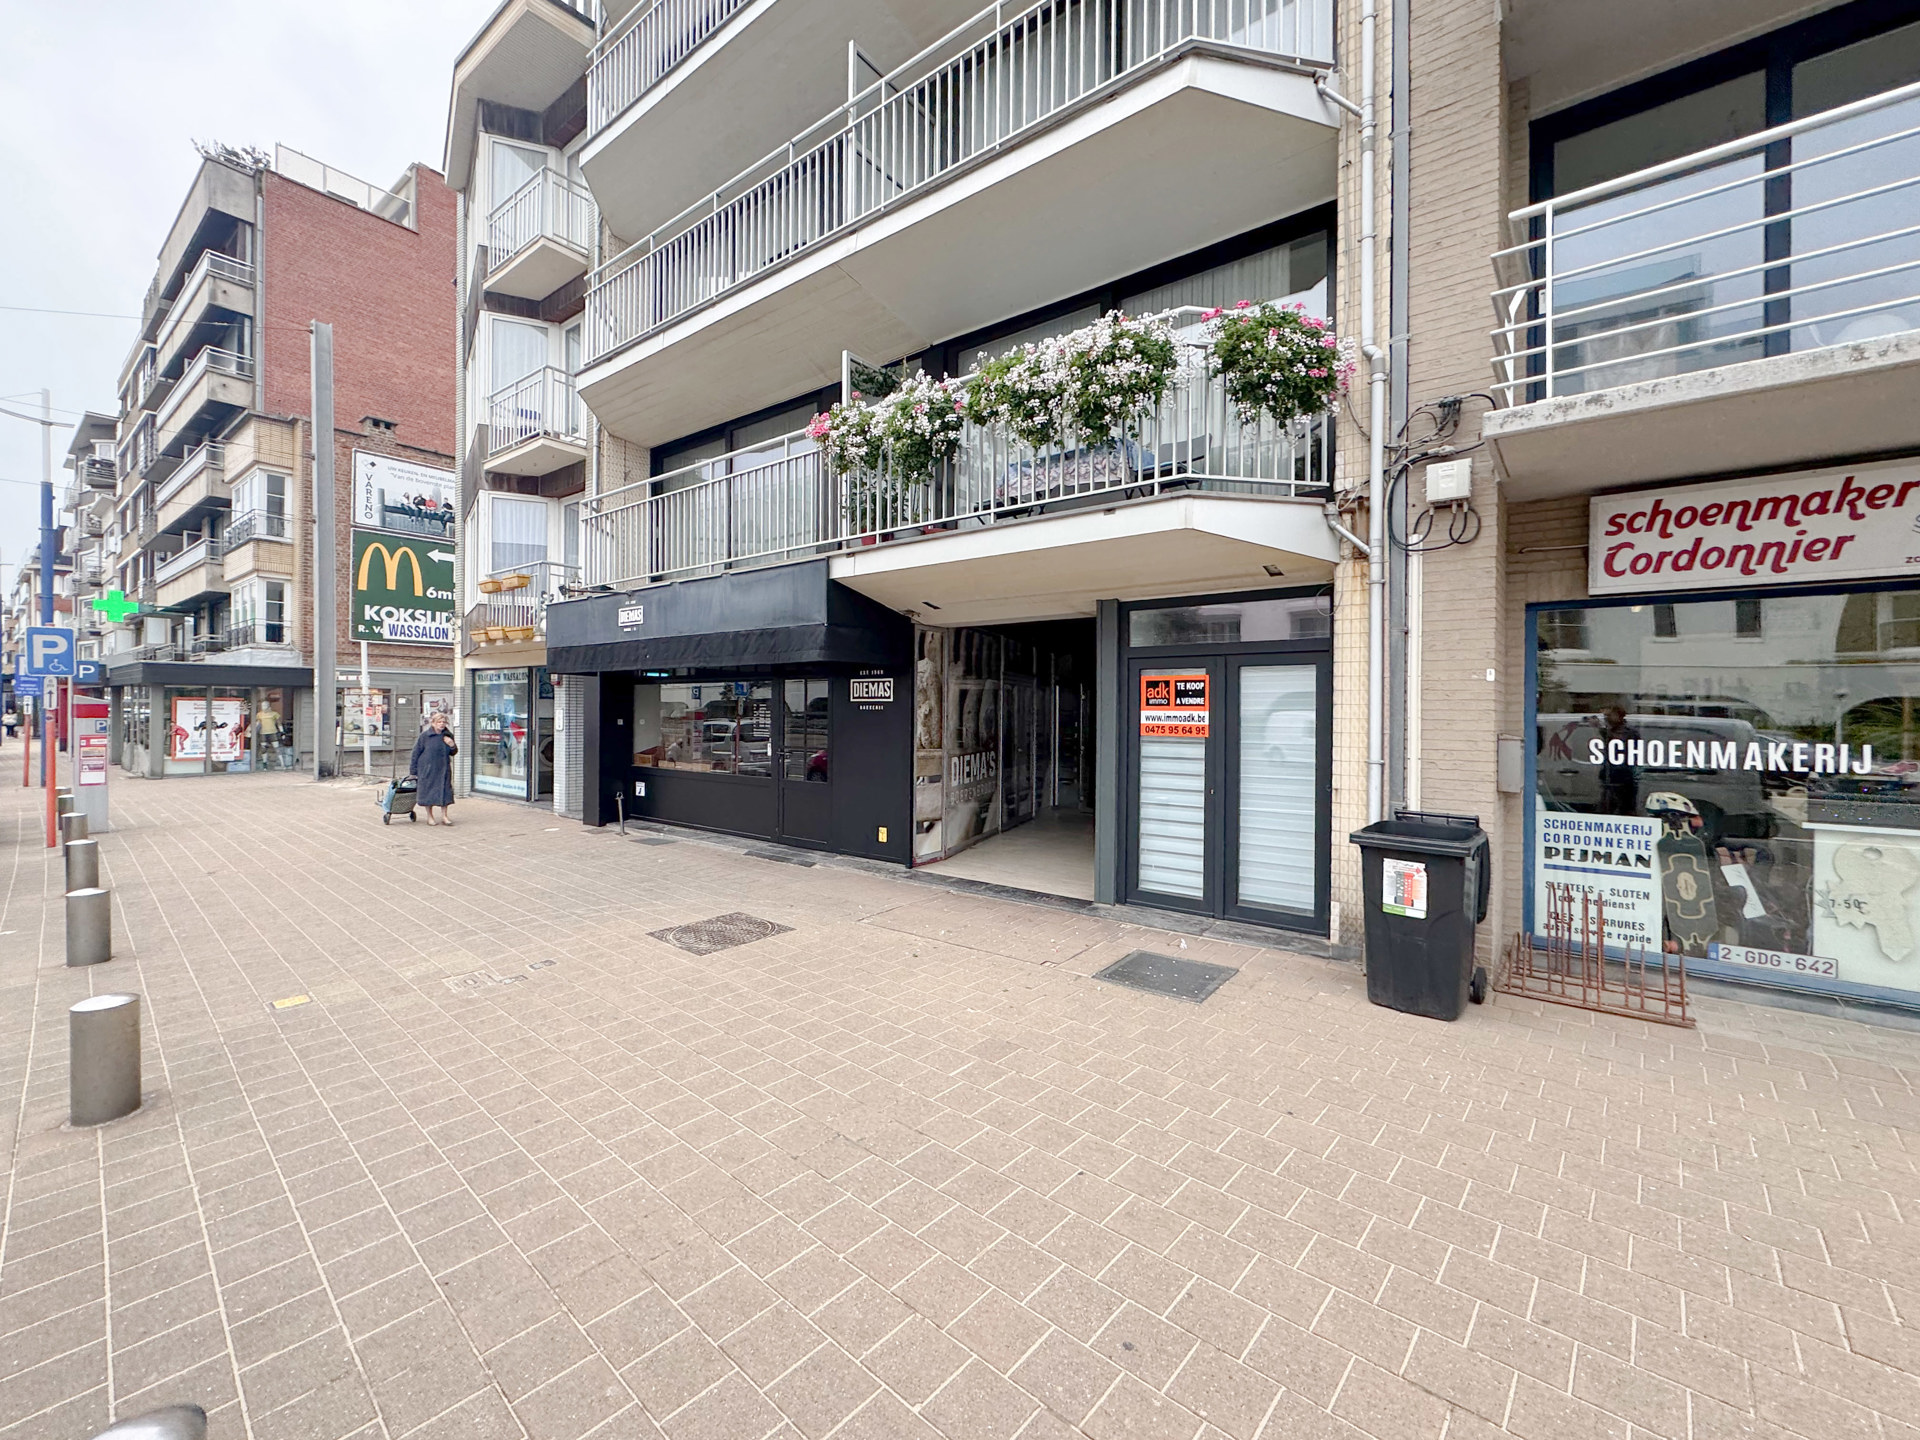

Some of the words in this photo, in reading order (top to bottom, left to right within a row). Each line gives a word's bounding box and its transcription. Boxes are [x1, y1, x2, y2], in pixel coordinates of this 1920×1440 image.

[364, 473, 374, 519] VARENO
[1603, 529, 1856, 578] Cordonnier
[388, 623, 448, 640] WASSALON
[32, 634, 68, 668] P
[79, 665, 95, 678] P
[854, 682, 890, 698] DIEMAS
[1147, 682, 1169, 698] adk
[1186, 682, 1204, 690] KOOP
[480, 718, 500, 730] Wash
[1145, 713, 1206, 722] www.immoadk.be
[96, 720, 106, 732] P
[1196, 726, 1206, 735] 95
[1588, 738, 1873, 775] SCHOENMAKERIJ
[952, 751, 996, 786] DIEMA'S
[1544, 819, 1652, 836] SCHOENMAKERIJ
[1544, 832, 1652, 851] CORDONNERIE
[1544, 846, 1652, 868] PEJMAN
[1545, 881, 1594, 894] SETELS
[1610, 888, 1650, 900] SLOTEN
[1590, 916, 1646, 931] SRRURES
[1618, 932, 1652, 944] rapide
